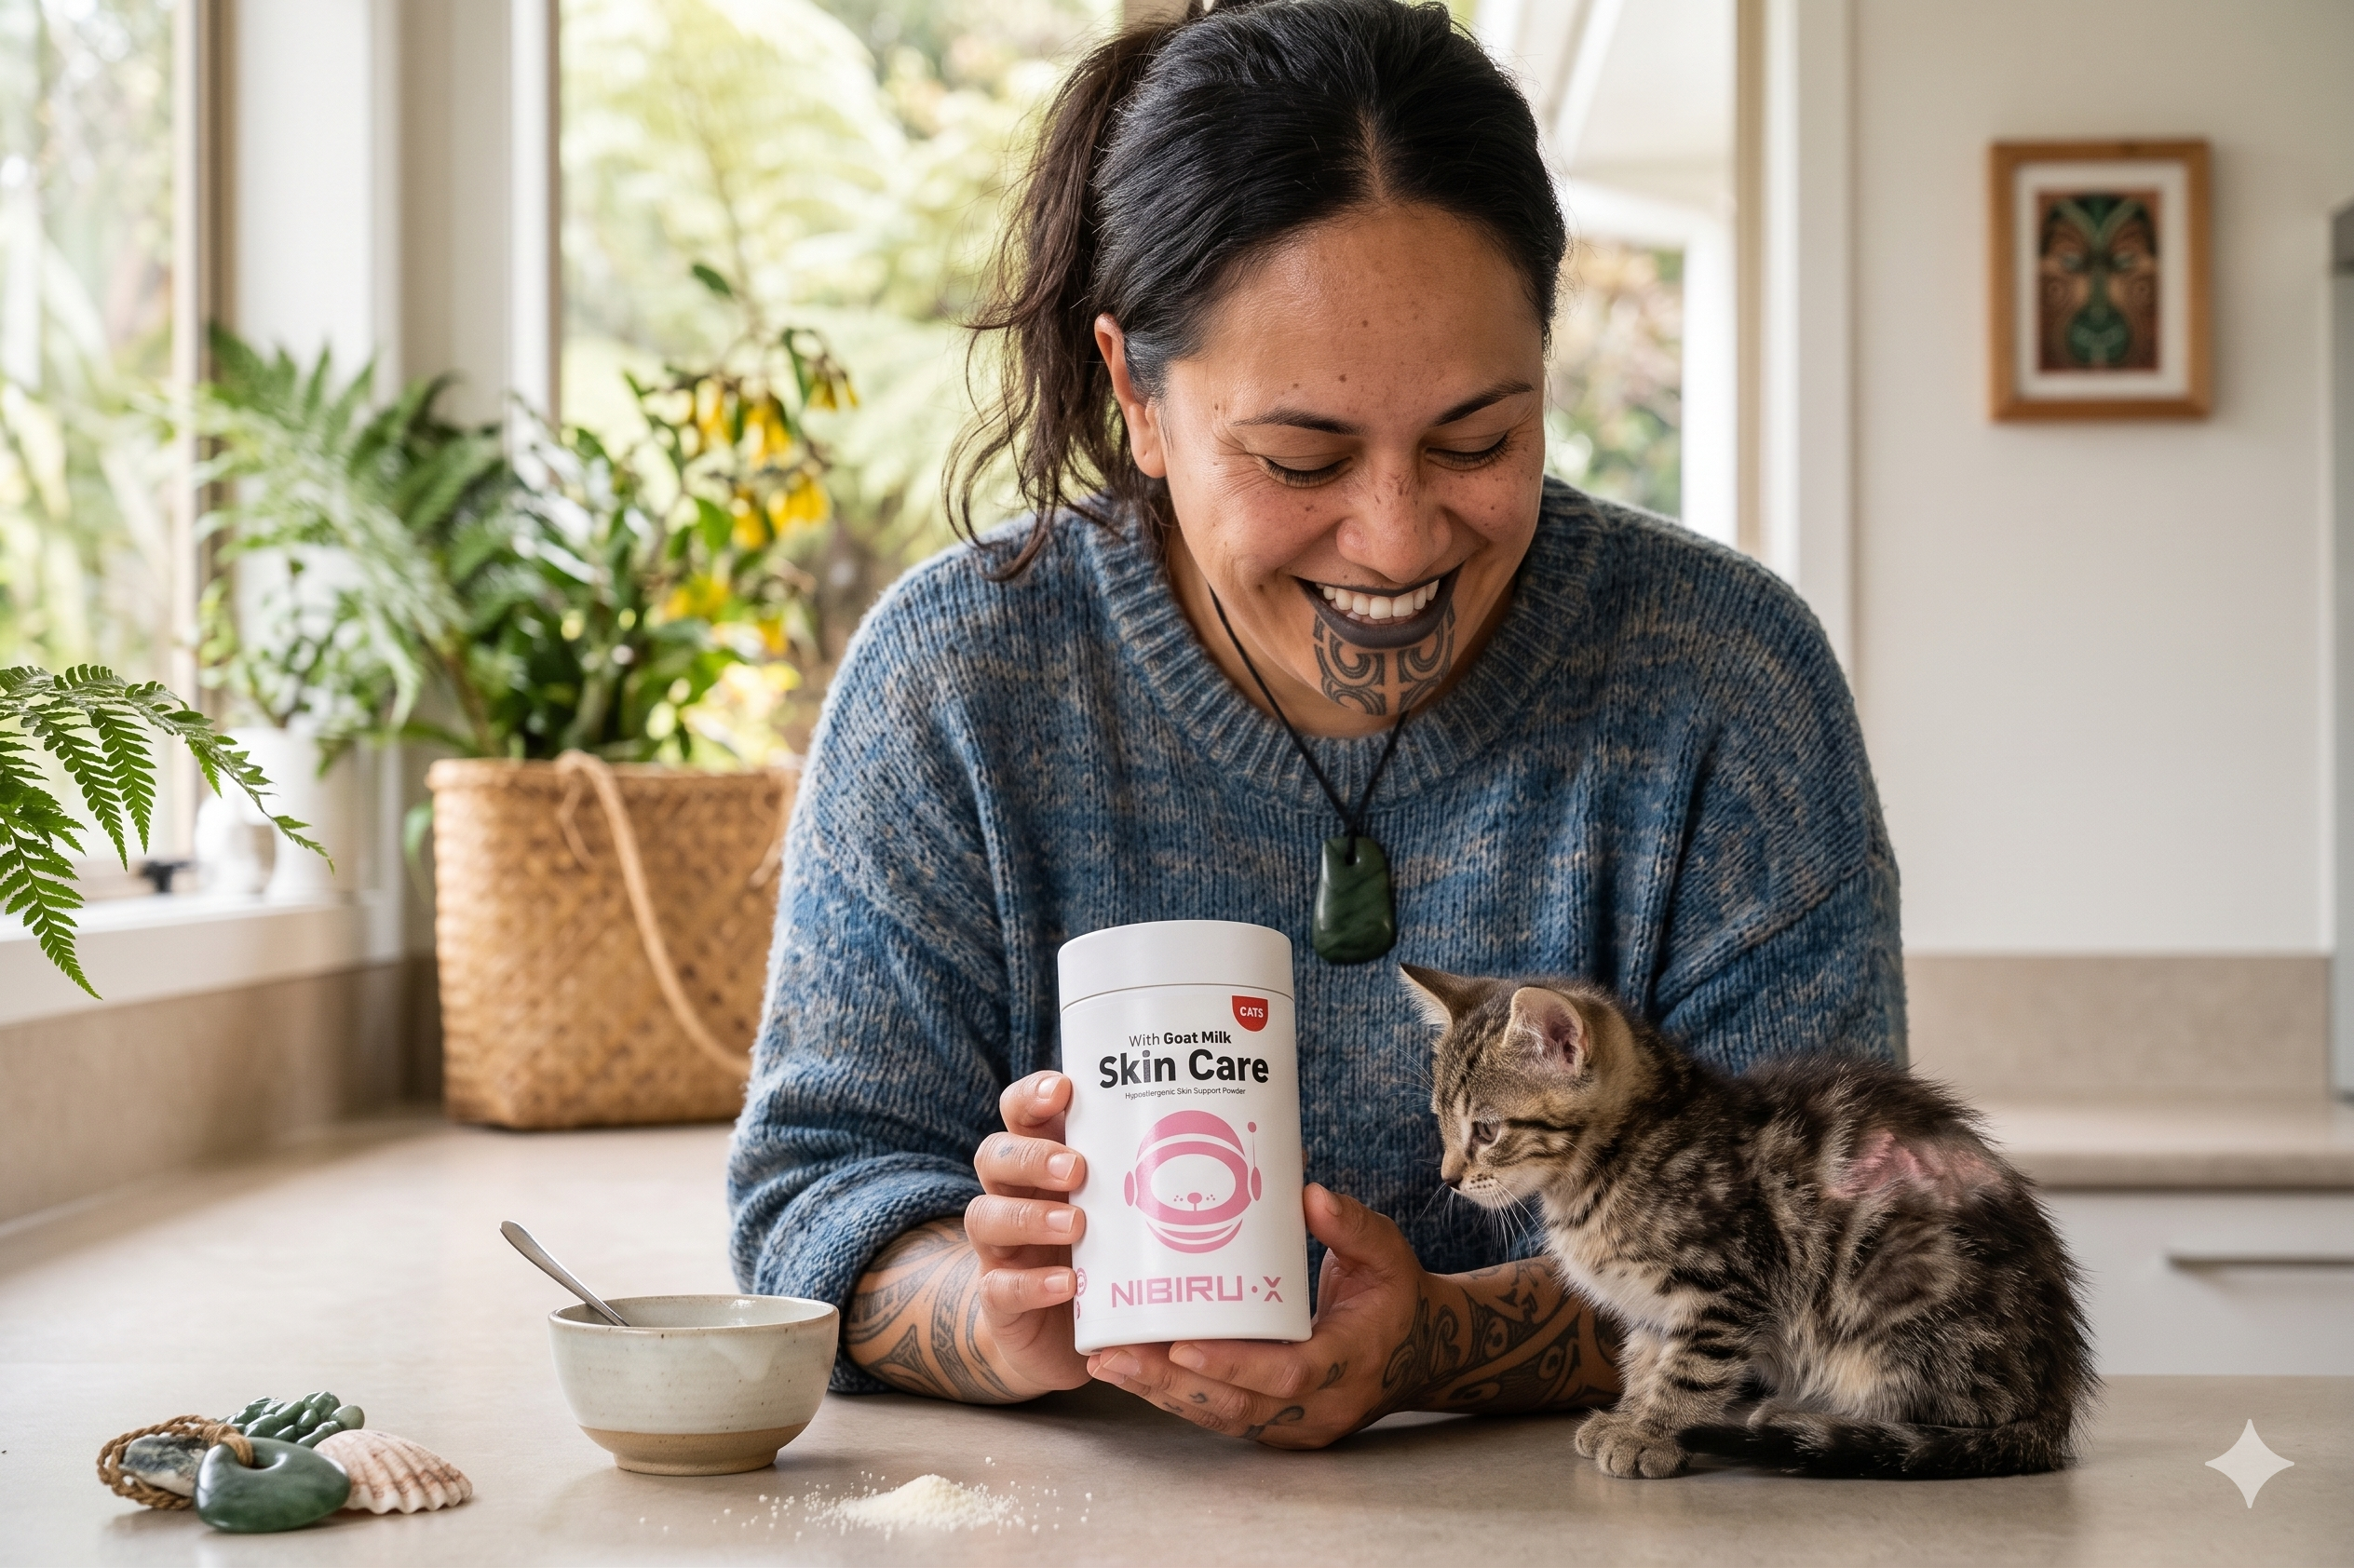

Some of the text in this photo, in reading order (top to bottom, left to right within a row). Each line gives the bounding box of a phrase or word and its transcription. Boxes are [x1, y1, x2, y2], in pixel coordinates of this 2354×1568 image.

[1239, 1006, 1264, 1018] CATS
[1130, 1031, 1232, 1047] With Goat Milk
[1099, 1048, 1269, 1088] Skin Care
[1176, 1087, 1192, 1095] Skin
[1193, 1087, 1221, 1095] Support
